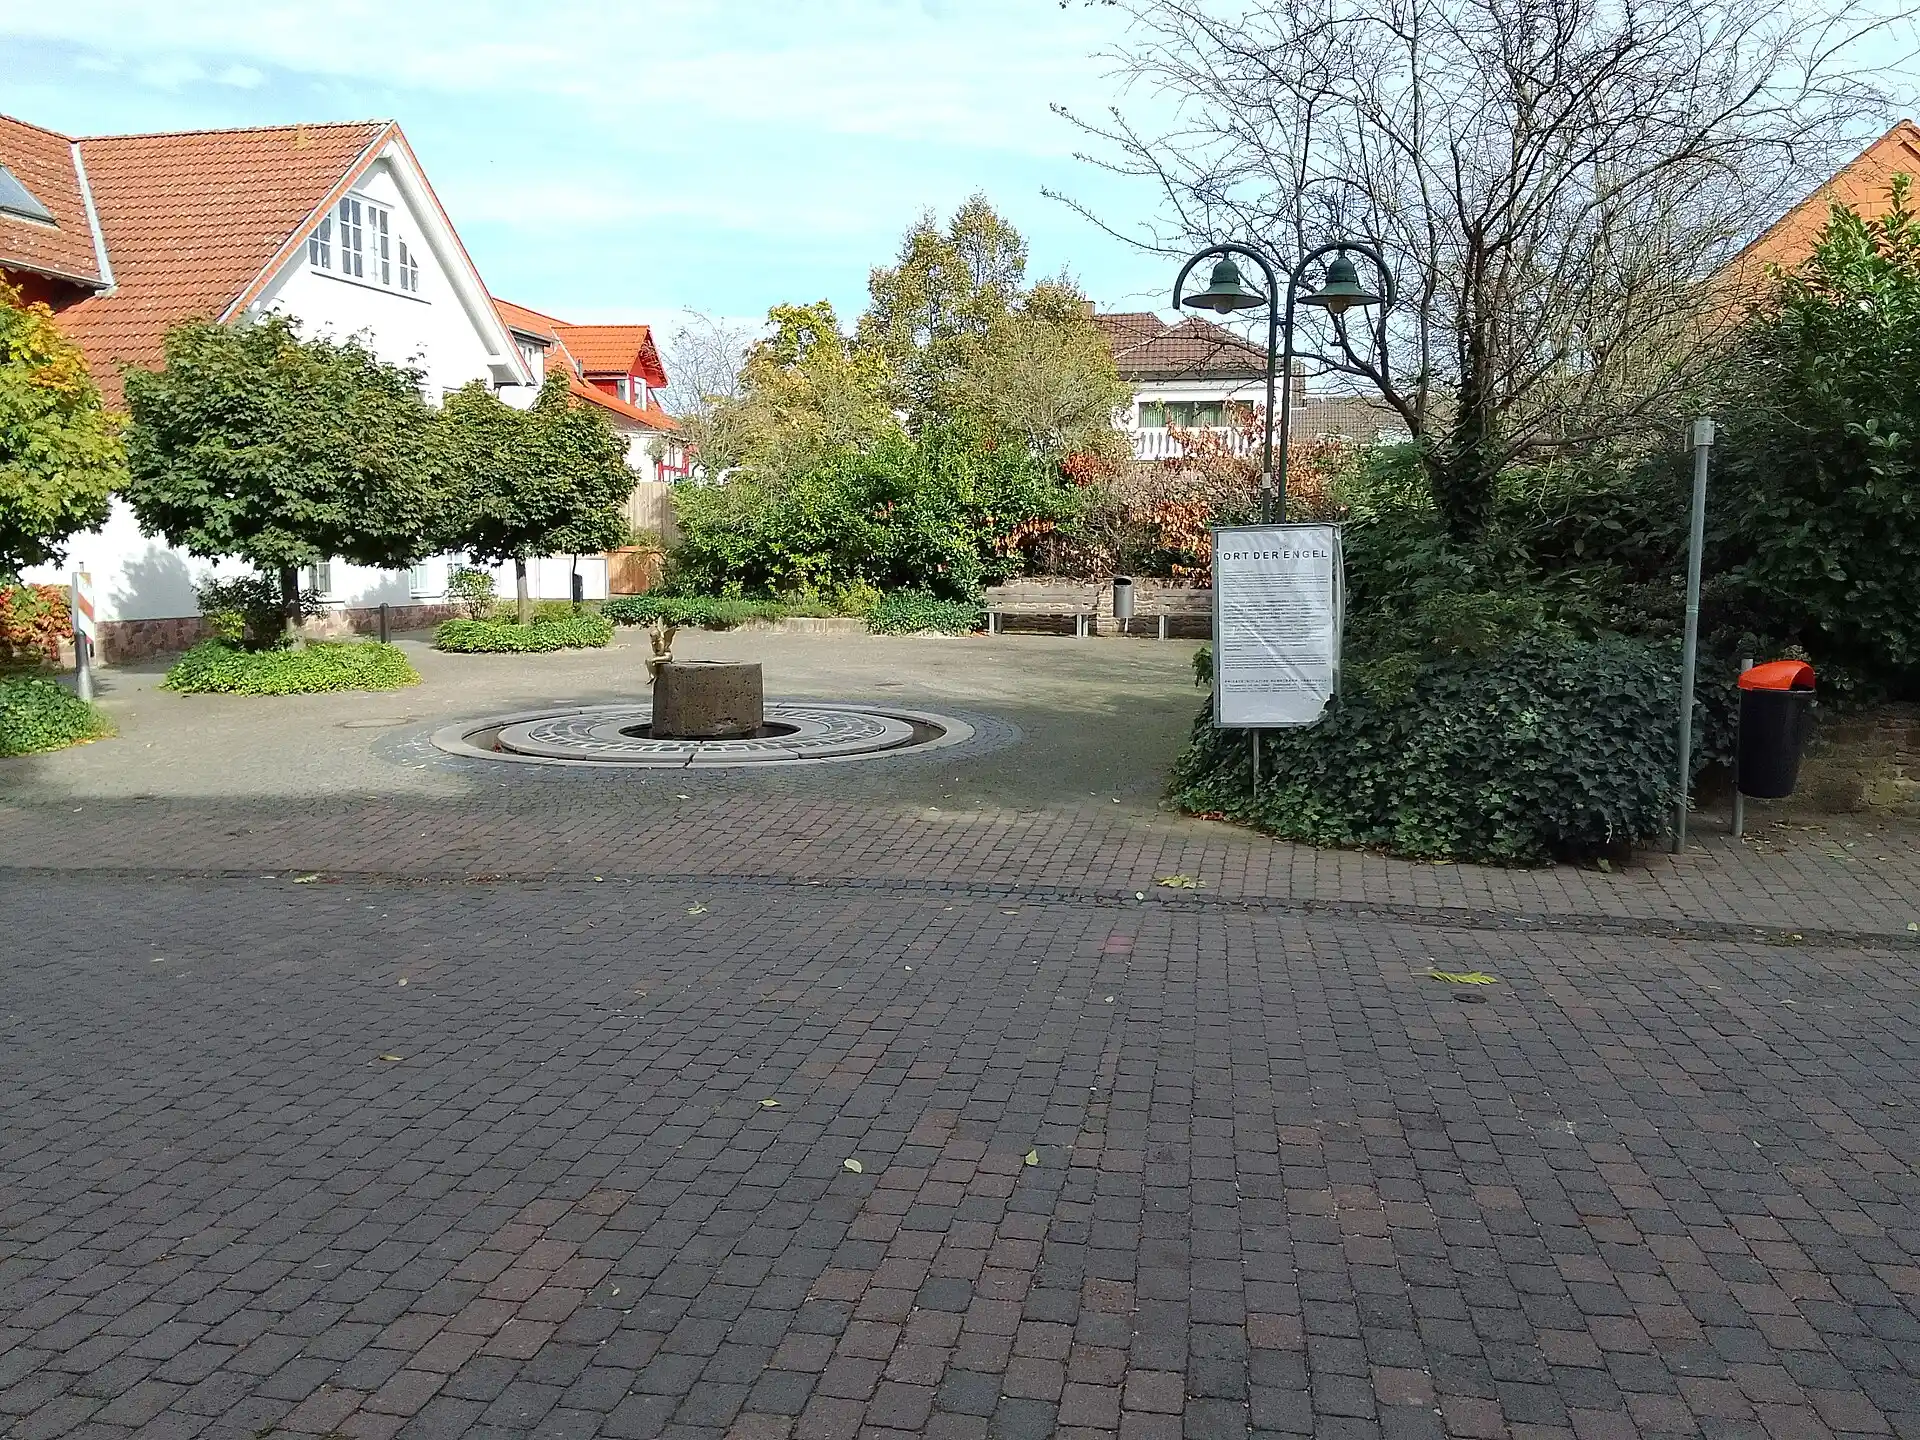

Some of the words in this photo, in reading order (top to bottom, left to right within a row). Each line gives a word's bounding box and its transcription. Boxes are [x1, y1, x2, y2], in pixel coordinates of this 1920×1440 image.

[1223, 551, 1249, 560] ORT
[1253, 551, 1279, 560] DER
[1283, 549, 1327, 558] ENGEL
